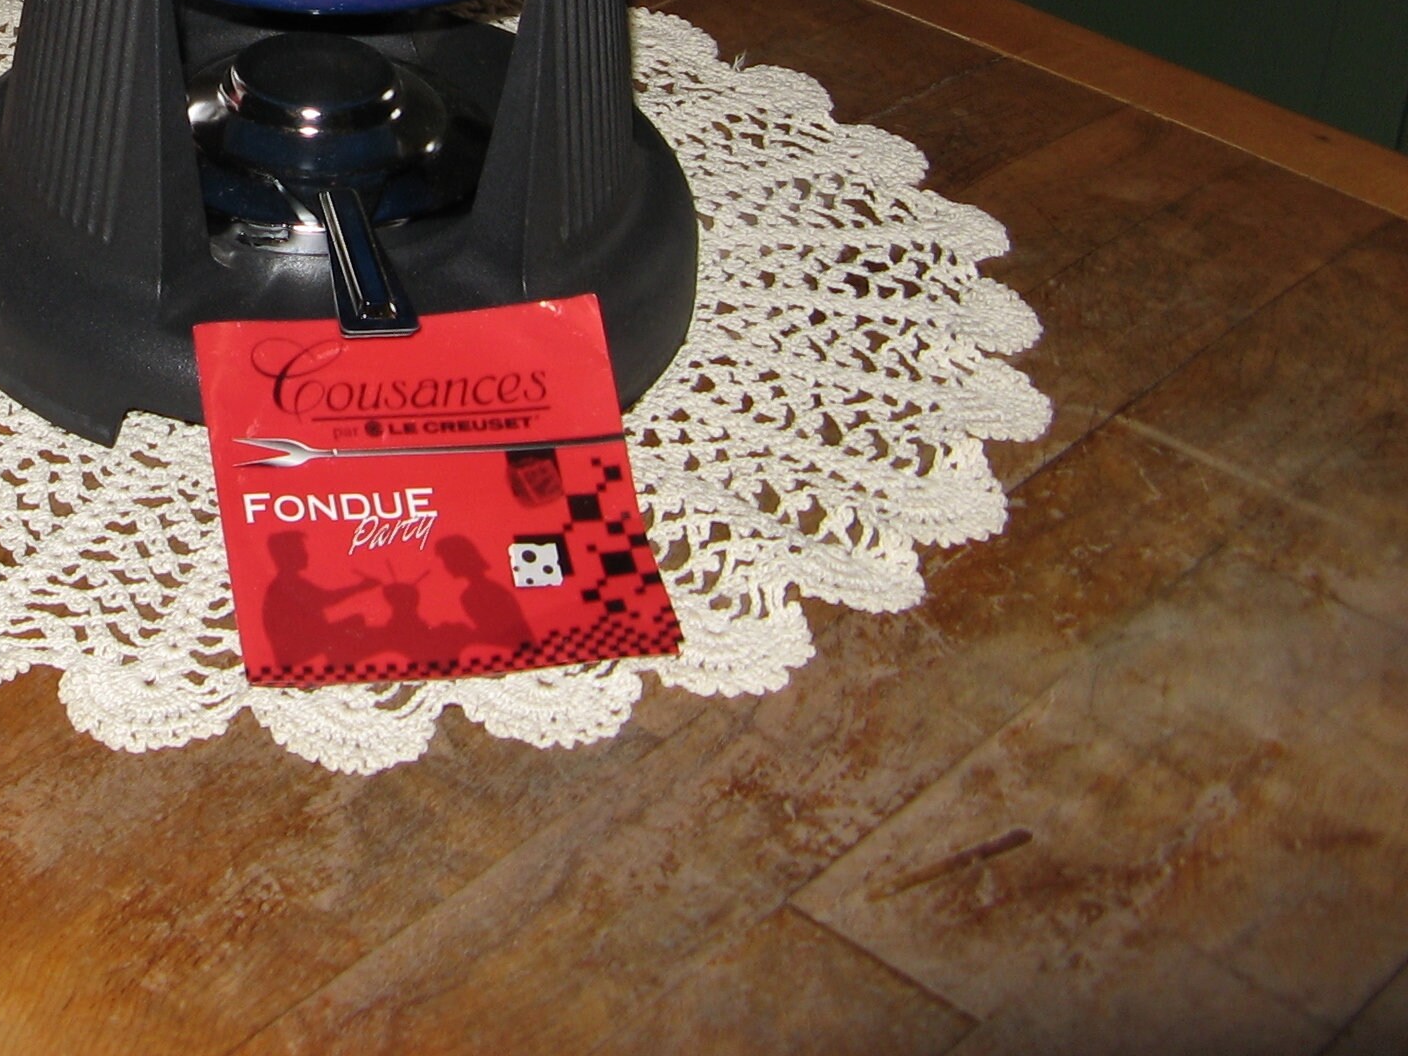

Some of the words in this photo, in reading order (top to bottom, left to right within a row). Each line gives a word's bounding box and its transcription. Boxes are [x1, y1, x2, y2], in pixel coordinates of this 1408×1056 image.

[250, 337, 548, 424] Cousances
[332, 425, 359, 441] par
[389, 422, 418, 435] LE
[423, 416, 534, 433] CREUSET
[242, 487, 438, 524] FONDUE
[349, 510, 438, 556] Party
